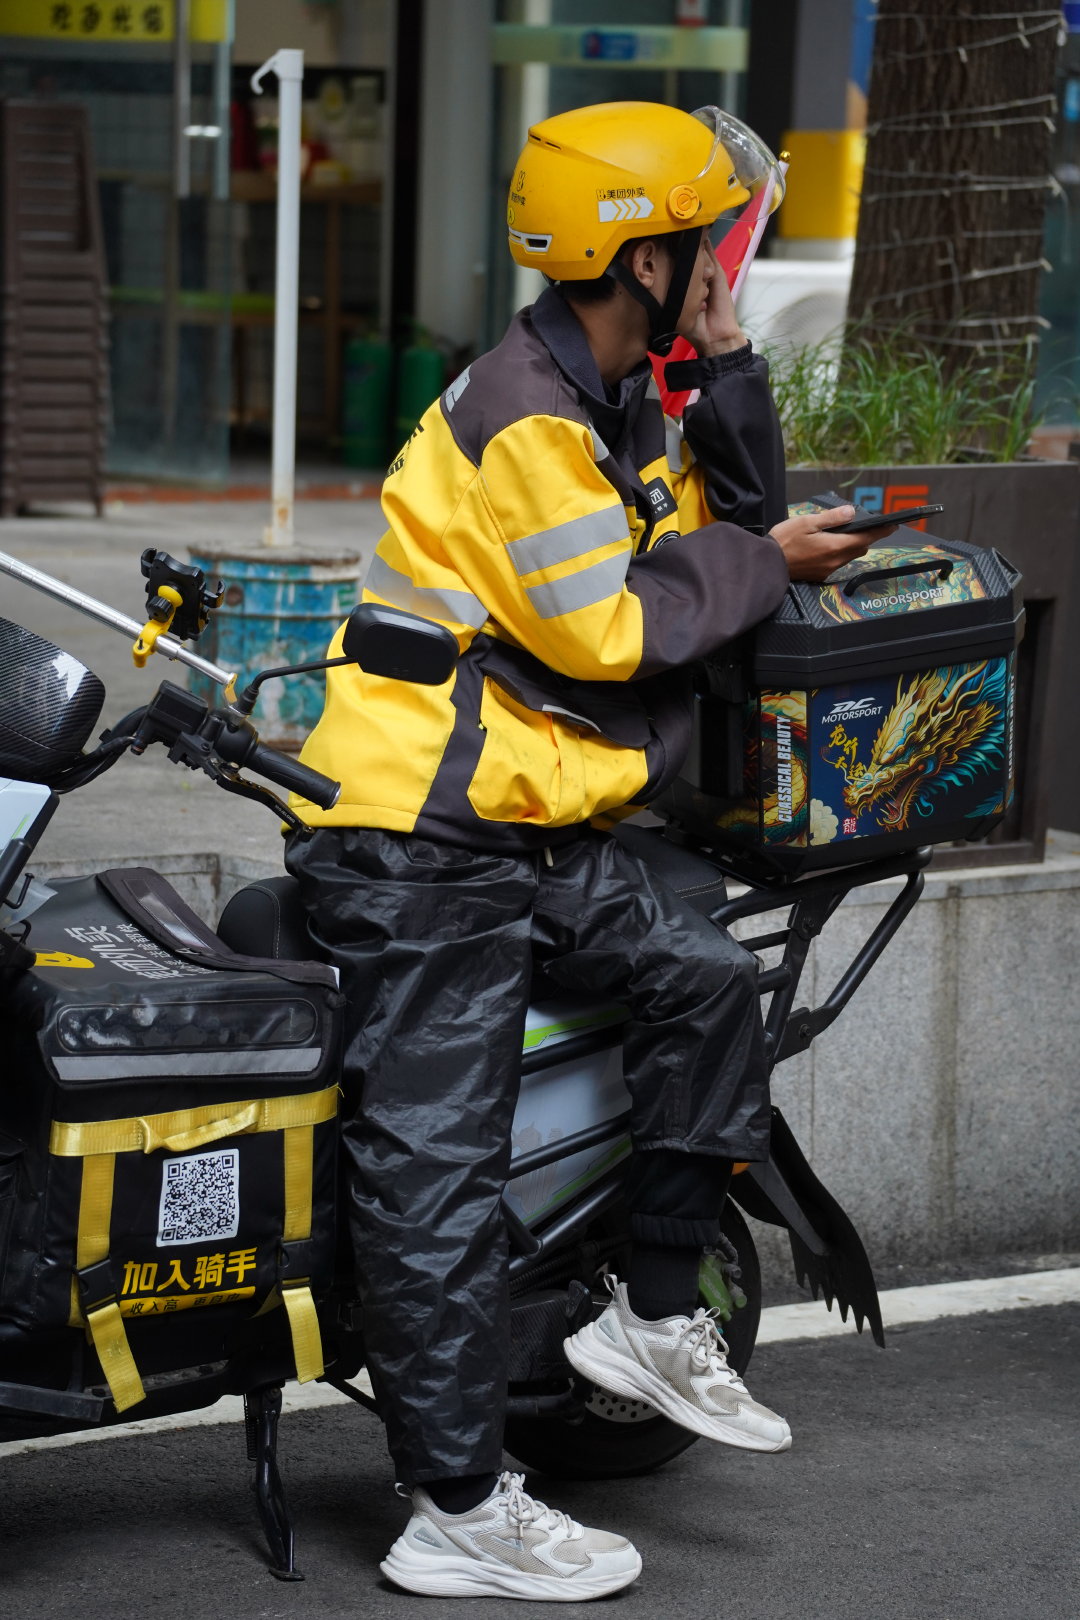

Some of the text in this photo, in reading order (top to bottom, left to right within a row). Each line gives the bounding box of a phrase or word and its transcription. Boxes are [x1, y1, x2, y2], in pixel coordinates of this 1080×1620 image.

[606, 186, 645, 199] 美团外卖
[861, 587, 944, 611] MOTORSPORT
[821, 705, 884, 724] MOTORSPORT
[776, 715, 793, 822] CLASSICAL BEAUTY
[121, 1247, 258, 1295] 加入骑手
[130, 1300, 180, 1315] 收入高
